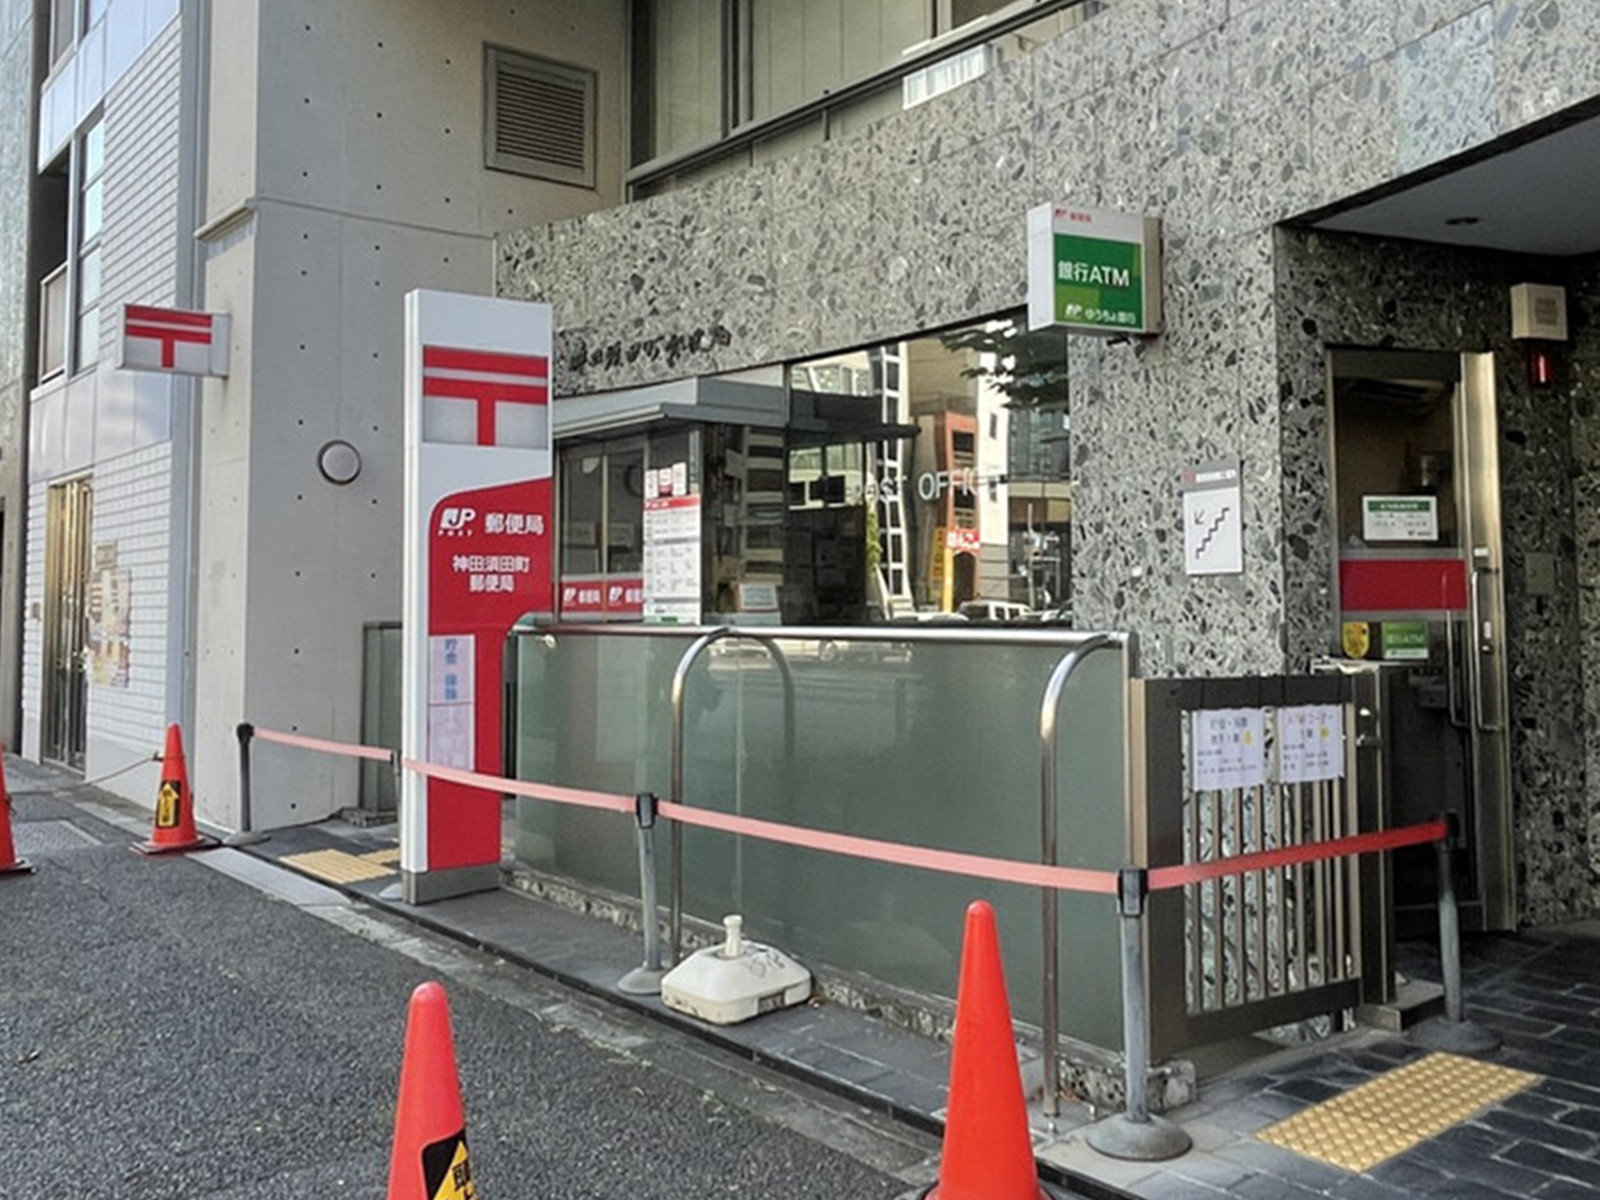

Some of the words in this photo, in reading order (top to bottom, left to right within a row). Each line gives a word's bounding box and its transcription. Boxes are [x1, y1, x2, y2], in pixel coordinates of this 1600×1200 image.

[1057, 260, 1130, 287] 銀行ATM
[918, 466, 986, 500] OFFIC
[441, 507, 476, 529] JP
[484, 513, 544, 536] 郵便局
[452, 554, 531, 573] 神田須田町
[470, 574, 515, 593] 郵便局
